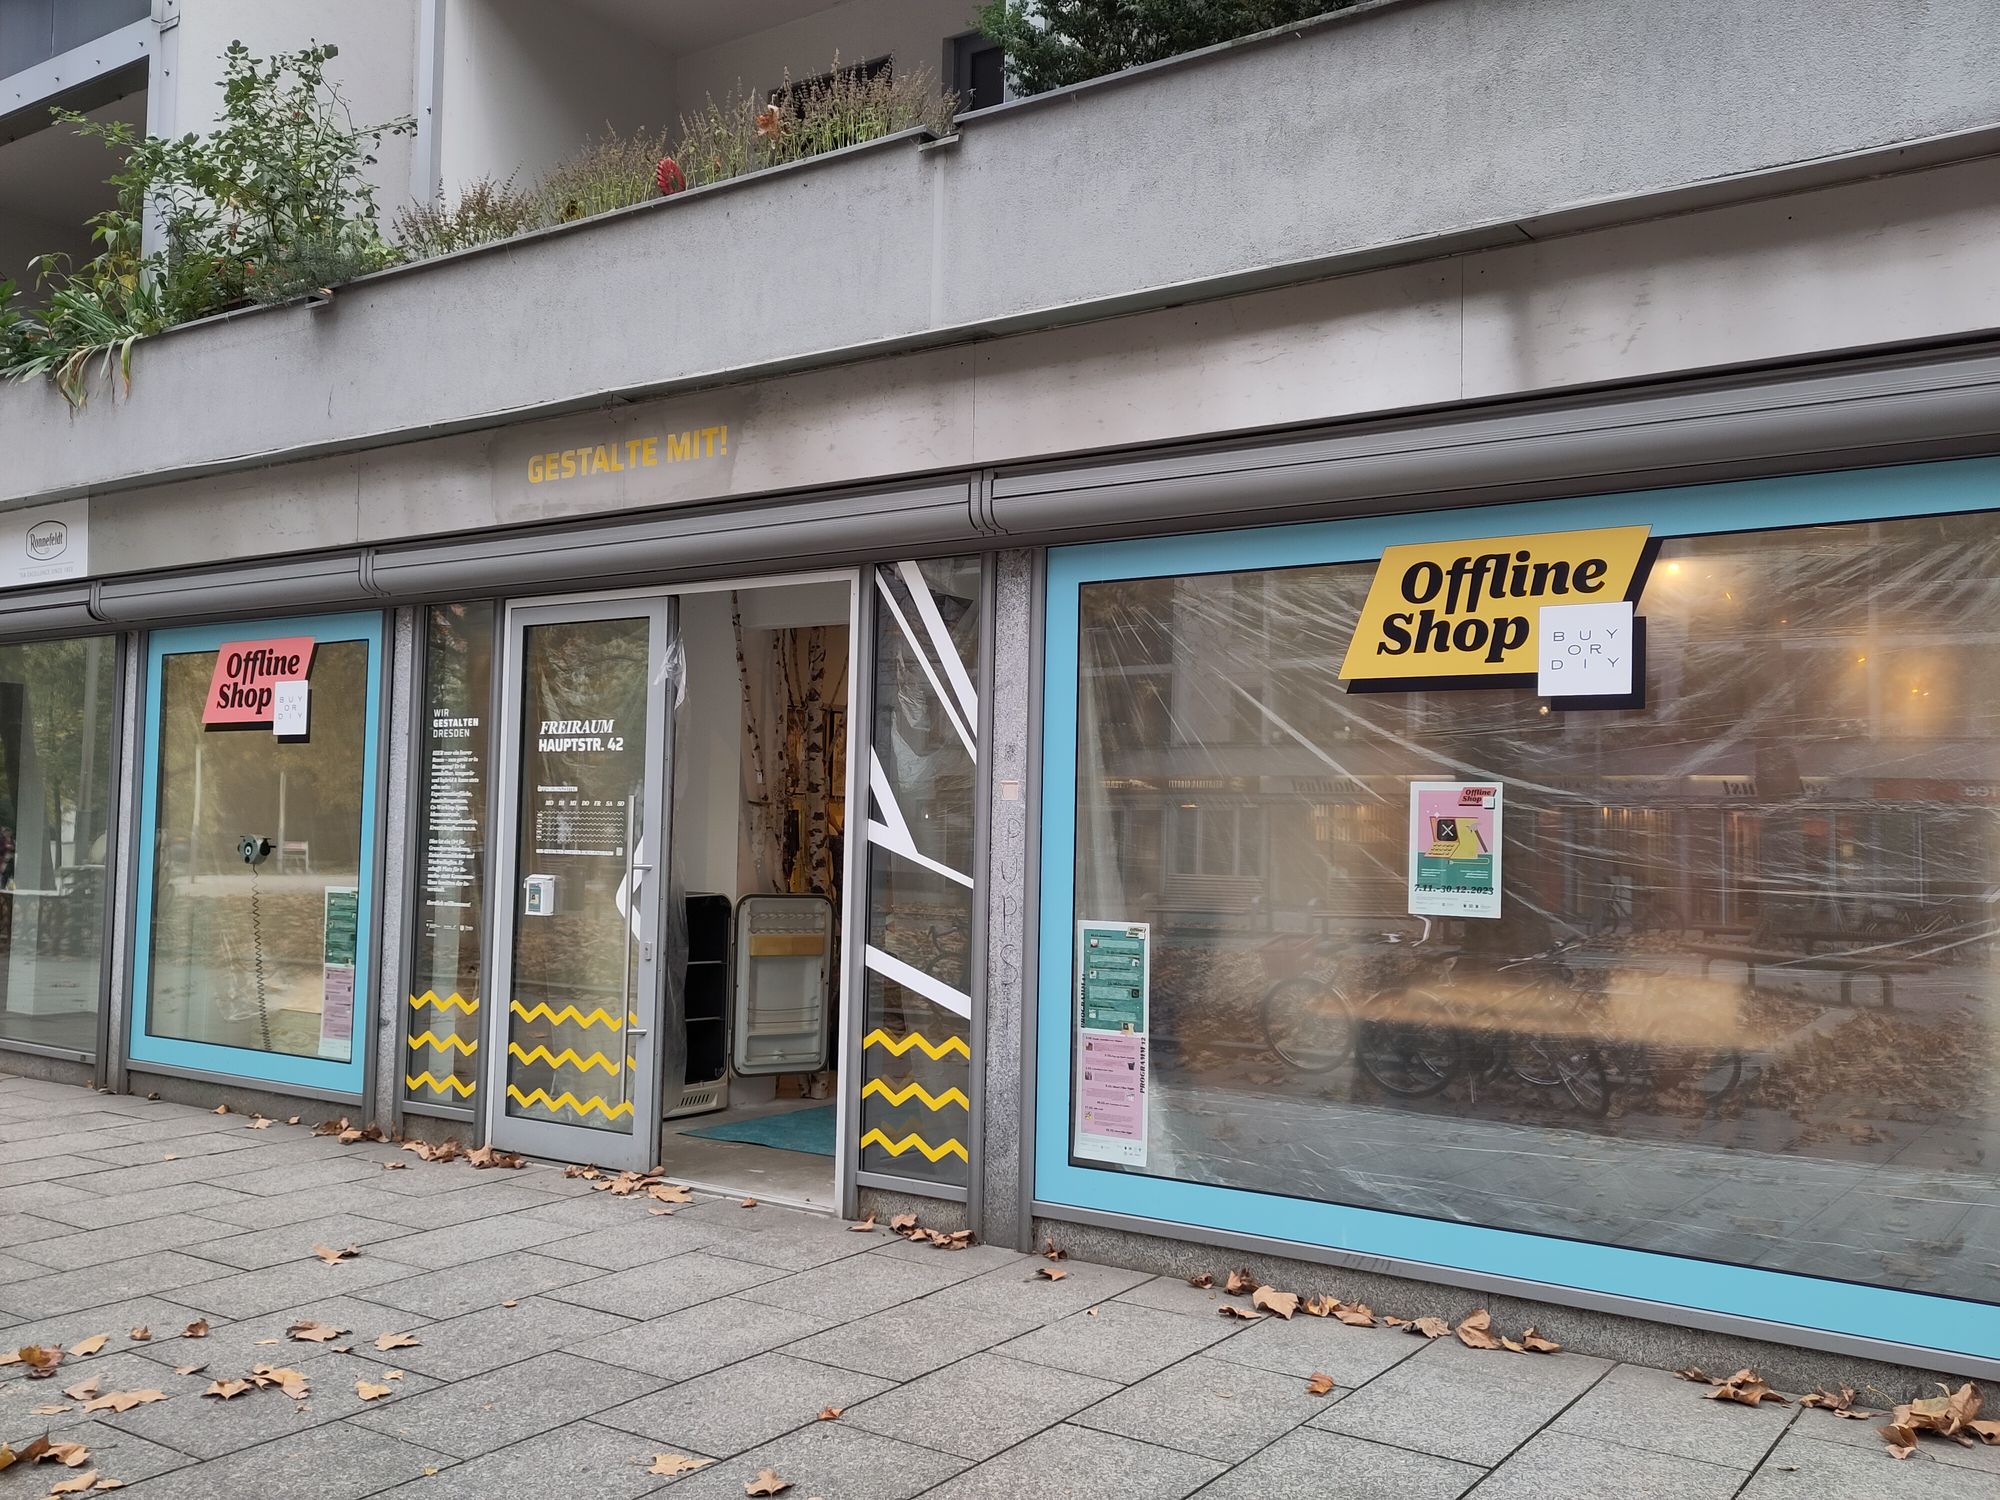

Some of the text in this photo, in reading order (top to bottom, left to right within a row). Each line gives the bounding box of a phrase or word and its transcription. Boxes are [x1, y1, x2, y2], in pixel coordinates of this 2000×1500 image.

[527, 425, 728, 484] GESTALTE MIT!
[30, 532, 63, 554] Ronnefeldt
[1400, 550, 1608, 615] Offline
[1376, 609, 1530, 664] Shop
[1552, 628, 1619, 643] BUY
[1567, 643, 1602, 656] OR
[226, 648, 300, 685] Offline
[1550, 656, 1620, 671] DIY
[216, 682, 273, 715] Shop
[279, 696, 303, 704] BUY
[284, 704, 297, 712] OR
[433, 708, 450, 718] WIR
[278, 712, 303, 720] DIY
[432, 717, 479, 728] GESTALTEN
[432, 728, 470, 738] DRESDEN
[540, 719, 615, 735] FREIRAUM
[538, 737, 624, 752] HAUPTSTR. 42
[1462, 796, 1482, 804] Shop
[1465, 789, 1492, 797] Offline
[1414, 884, 1494, 896] 7.11.-30.12.2023
